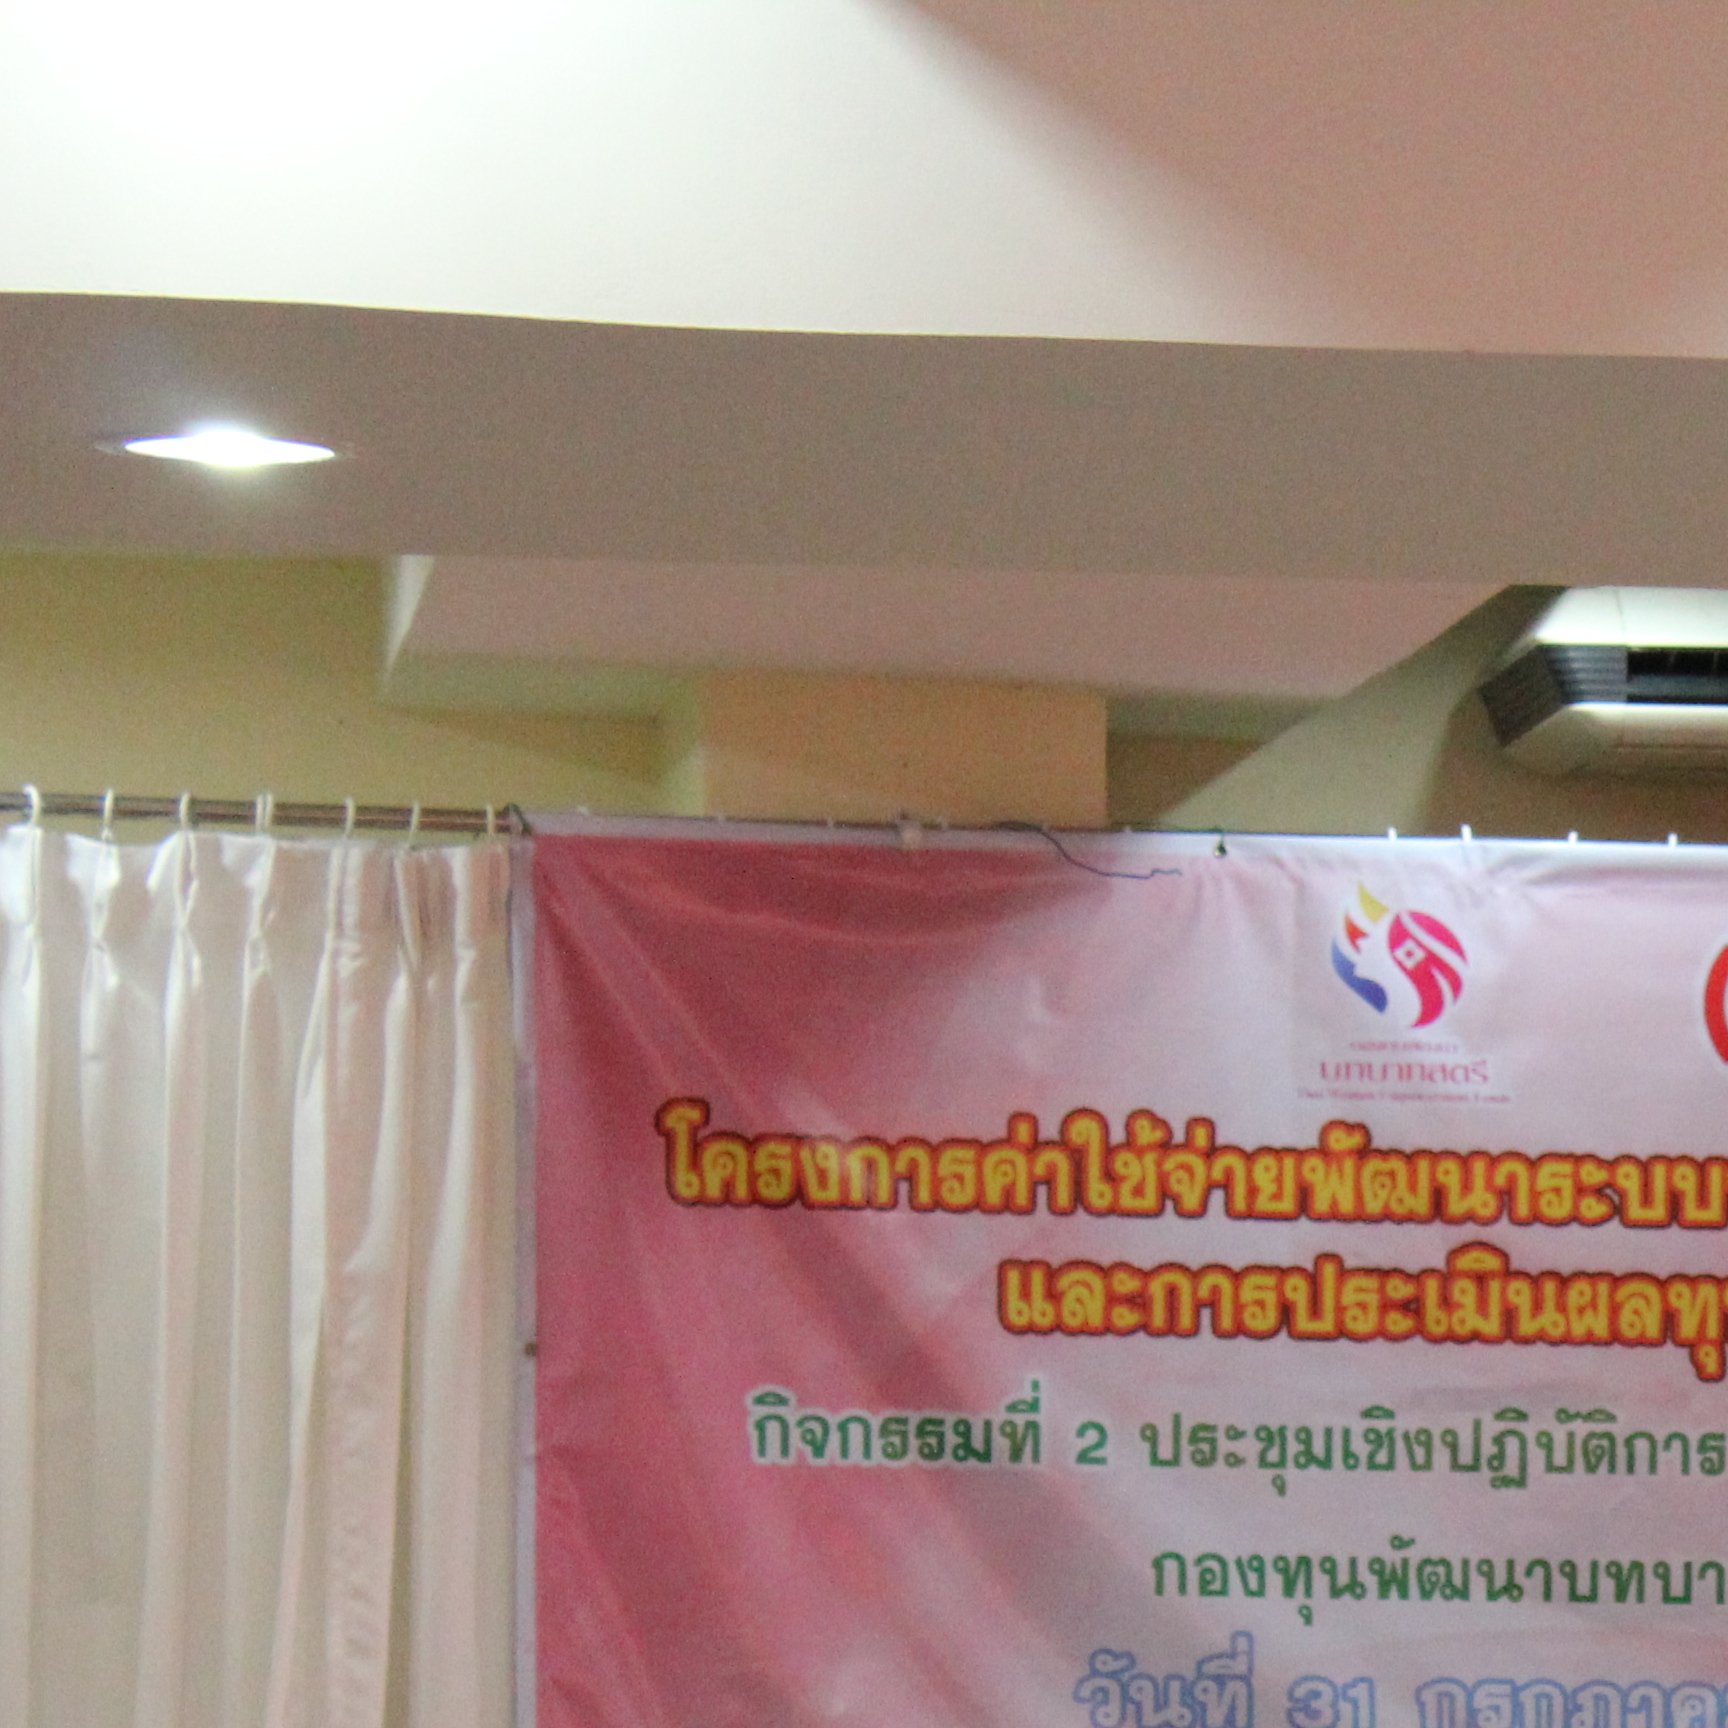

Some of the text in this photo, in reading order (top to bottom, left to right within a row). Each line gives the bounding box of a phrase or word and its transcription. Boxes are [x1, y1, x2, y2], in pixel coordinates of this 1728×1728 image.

[750, 1380, 1044, 1466] กิจกรรมที่
[1074, 1421, 1109, 1466] 2
[1140, 1406, 1727, 1496] ประชุมเชิงปฏิบัติการ
